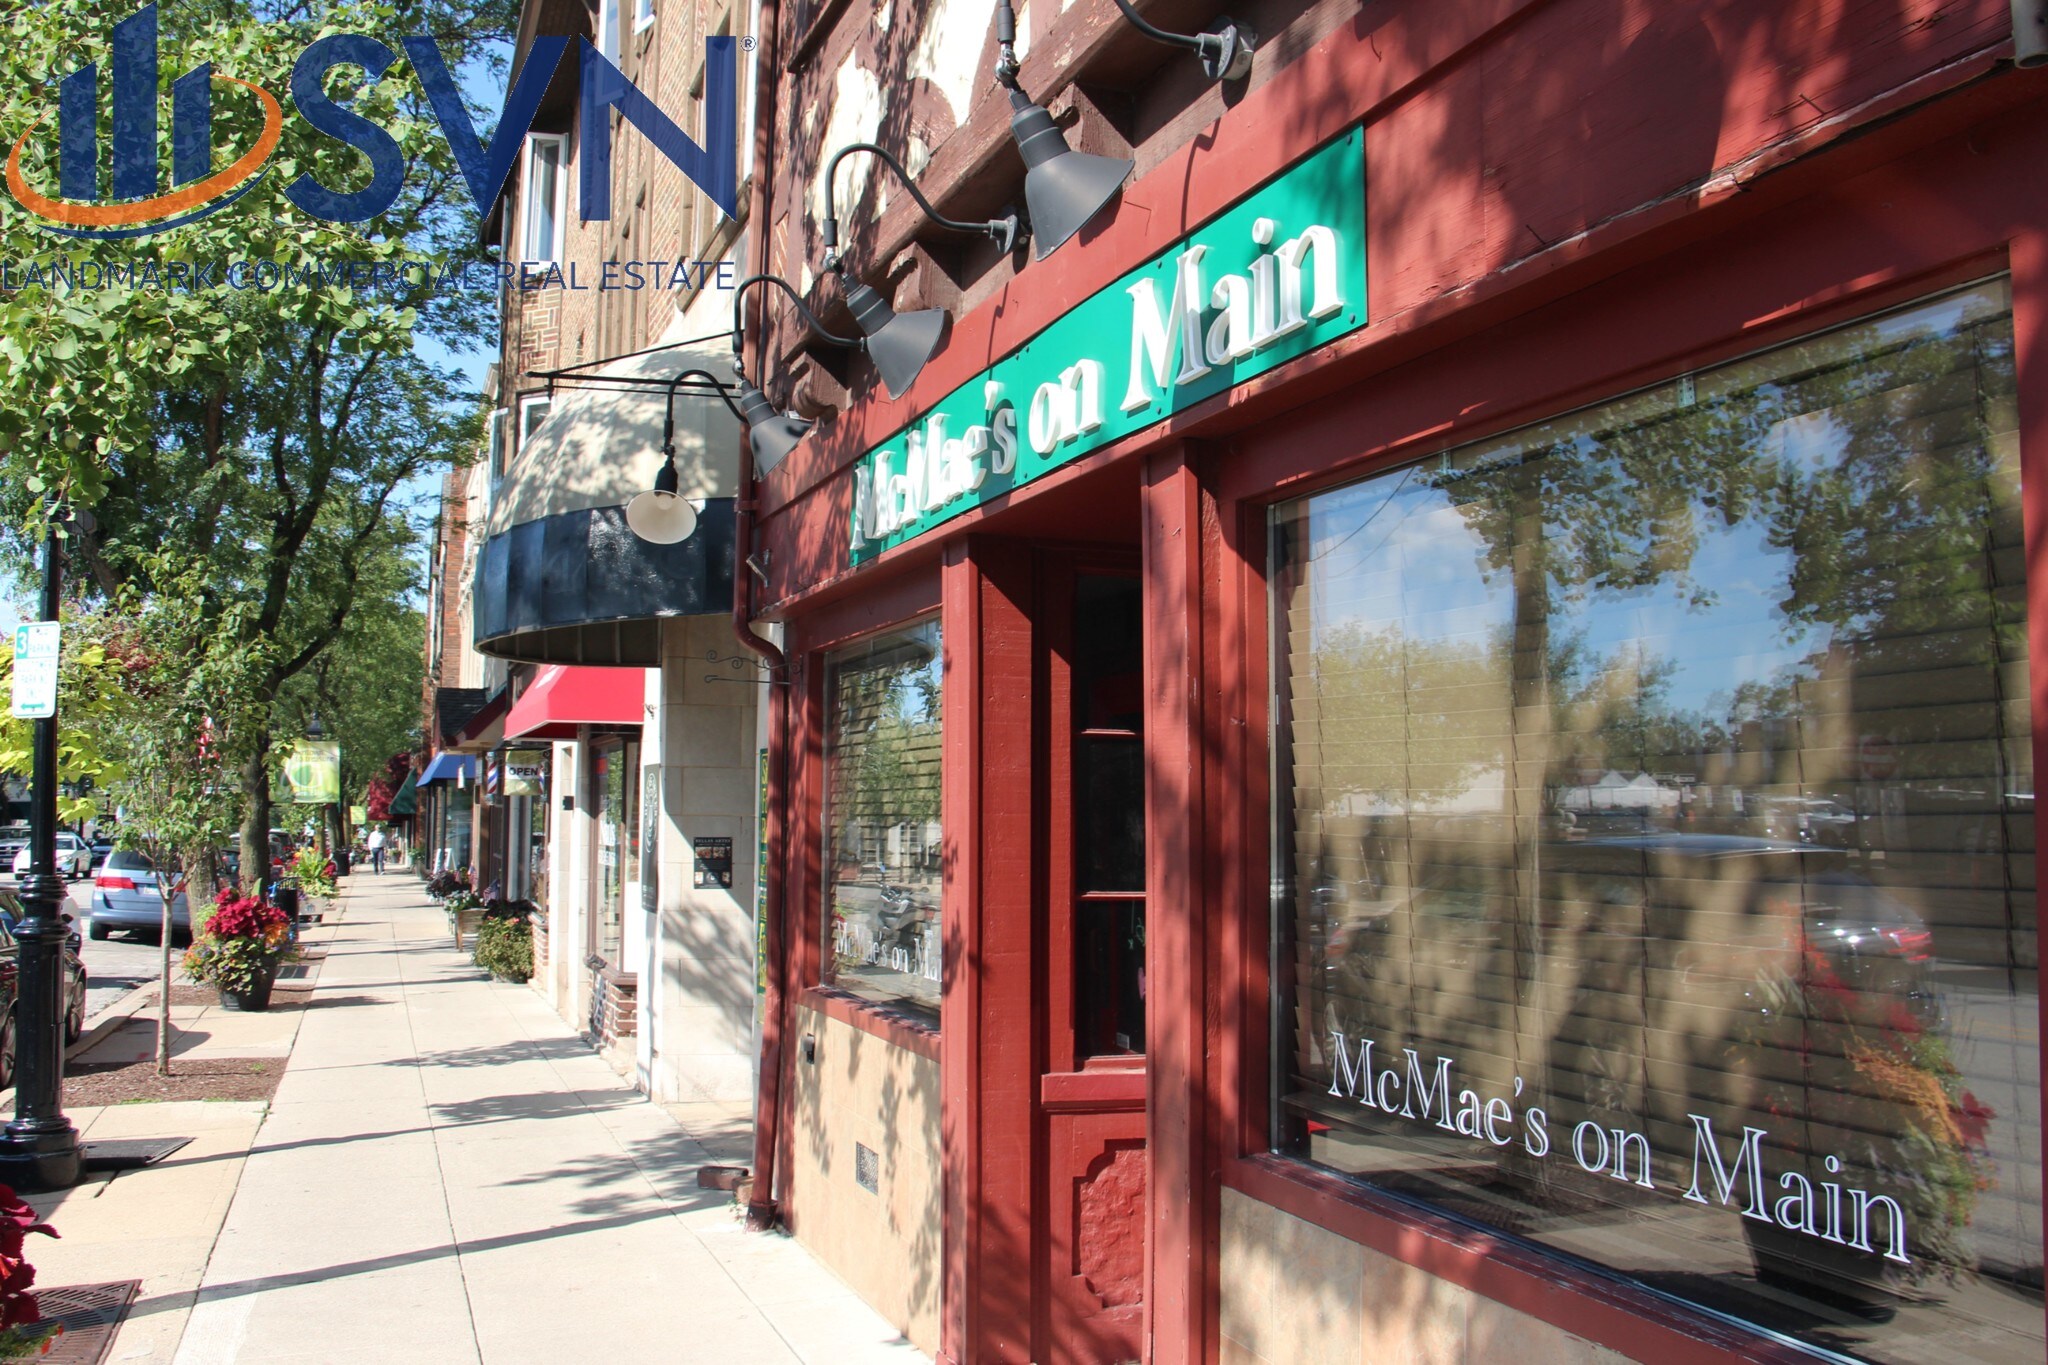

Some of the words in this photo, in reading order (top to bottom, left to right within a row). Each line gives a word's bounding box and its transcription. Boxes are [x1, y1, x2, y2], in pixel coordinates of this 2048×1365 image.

[850, 380, 1018, 550] McMae's
[1028, 358, 1106, 455] on
[1119, 217, 1346, 412] Main
[509, 767, 539, 776] OPEN
[892, 946, 909, 974] on
[1328, 1031, 1550, 1158] McMae's
[1572, 1120, 1655, 1190] on
[1683, 1113, 1911, 1264] Main
